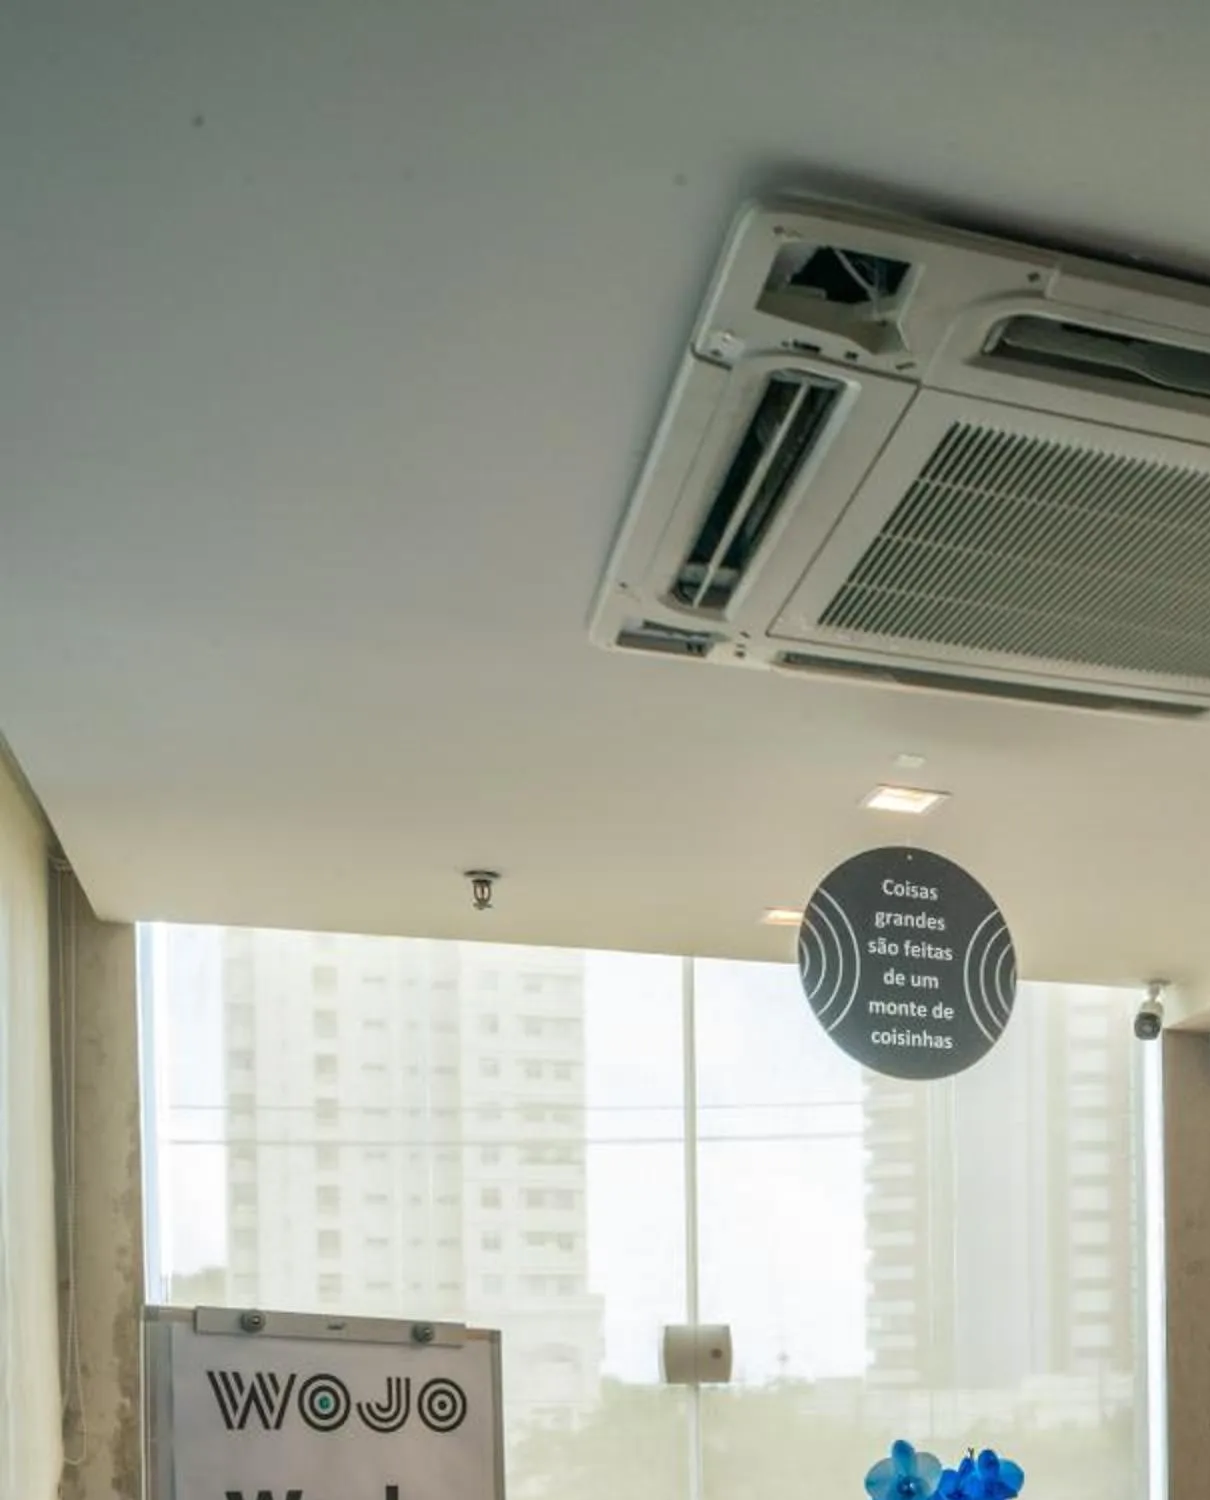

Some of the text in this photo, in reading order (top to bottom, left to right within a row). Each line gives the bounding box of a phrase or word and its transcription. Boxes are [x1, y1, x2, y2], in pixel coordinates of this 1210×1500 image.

[881, 879, 939, 901] Coisas
[874, 911, 945, 931] grandes
[868, 937, 953, 961] são feitas
[883, 968, 939, 989] de um
[869, 999, 954, 1020] monte de
[871, 1029, 953, 1049] coisinhas
[206, 1370, 468, 1433] WOJO
